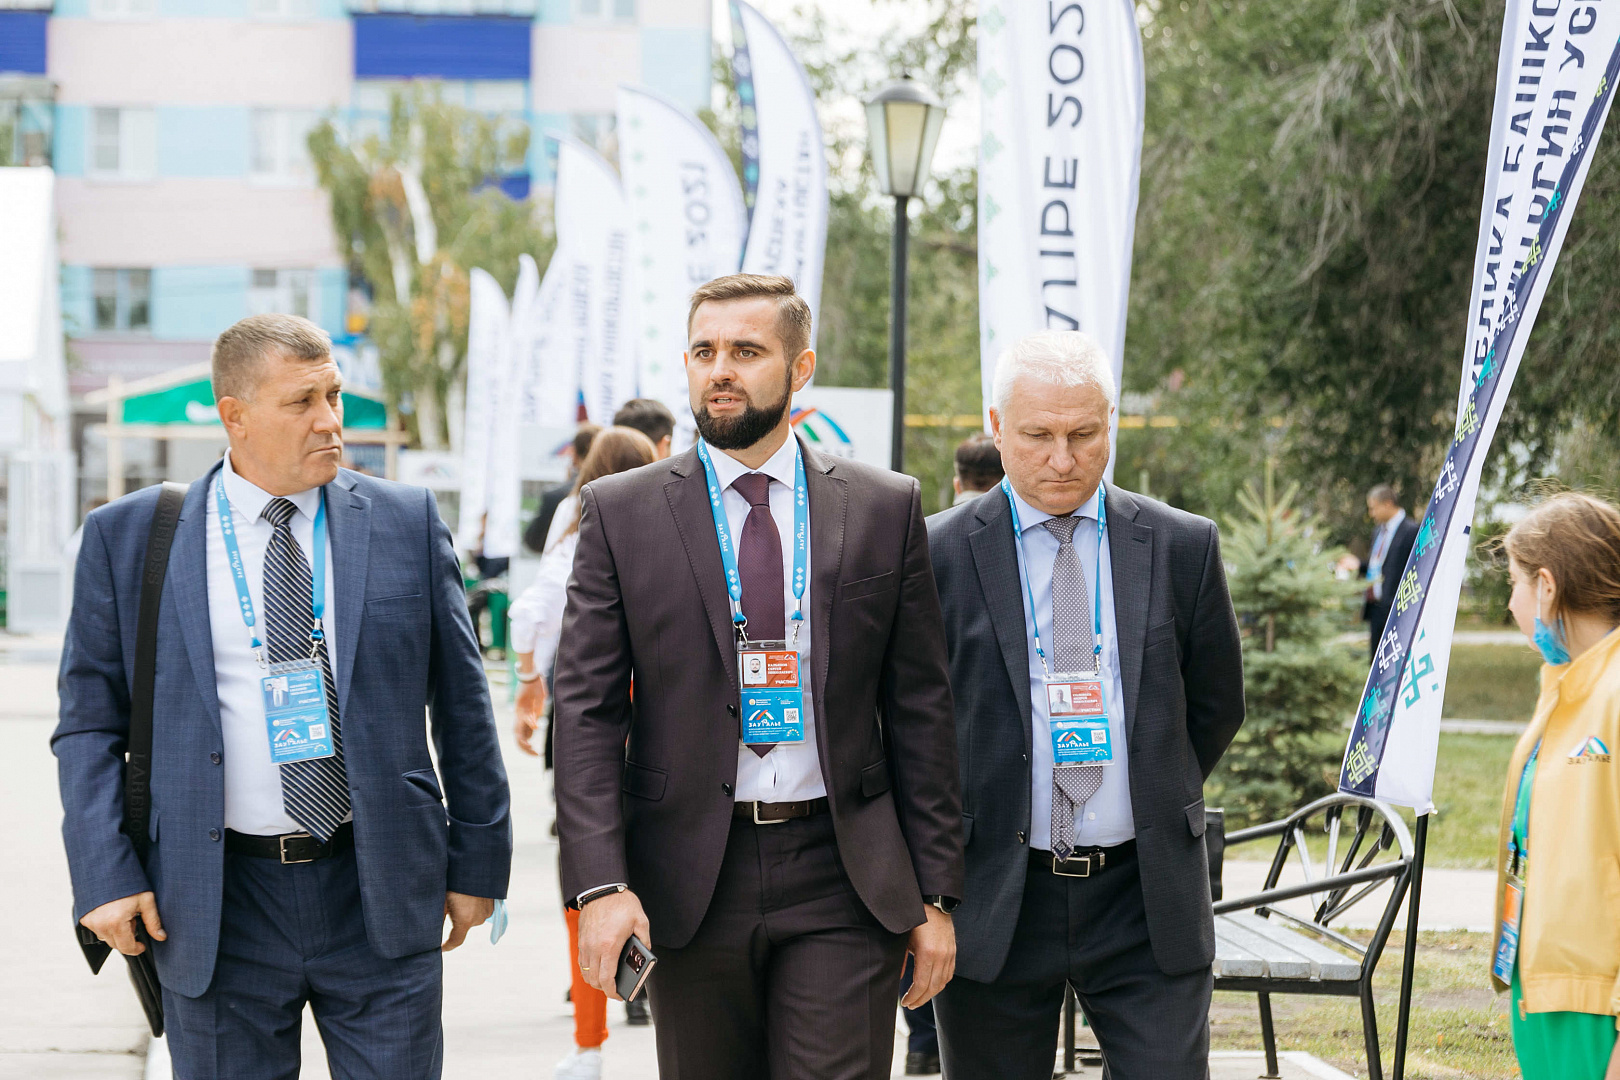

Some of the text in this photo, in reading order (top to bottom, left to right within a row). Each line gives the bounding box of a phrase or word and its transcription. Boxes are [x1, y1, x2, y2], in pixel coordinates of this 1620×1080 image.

[717, 523, 729, 552] ЗАУРАЛЬЕ
[795, 522, 805, 551] ЗАУРАЛЬЕ
[231, 550, 243, 579] ЗАУРАЛЬЕ
[748, 718, 782, 728] ЗАУРАЛЬЕ
[1057, 740, 1090, 749] ЗАУРАЛЬЕ
